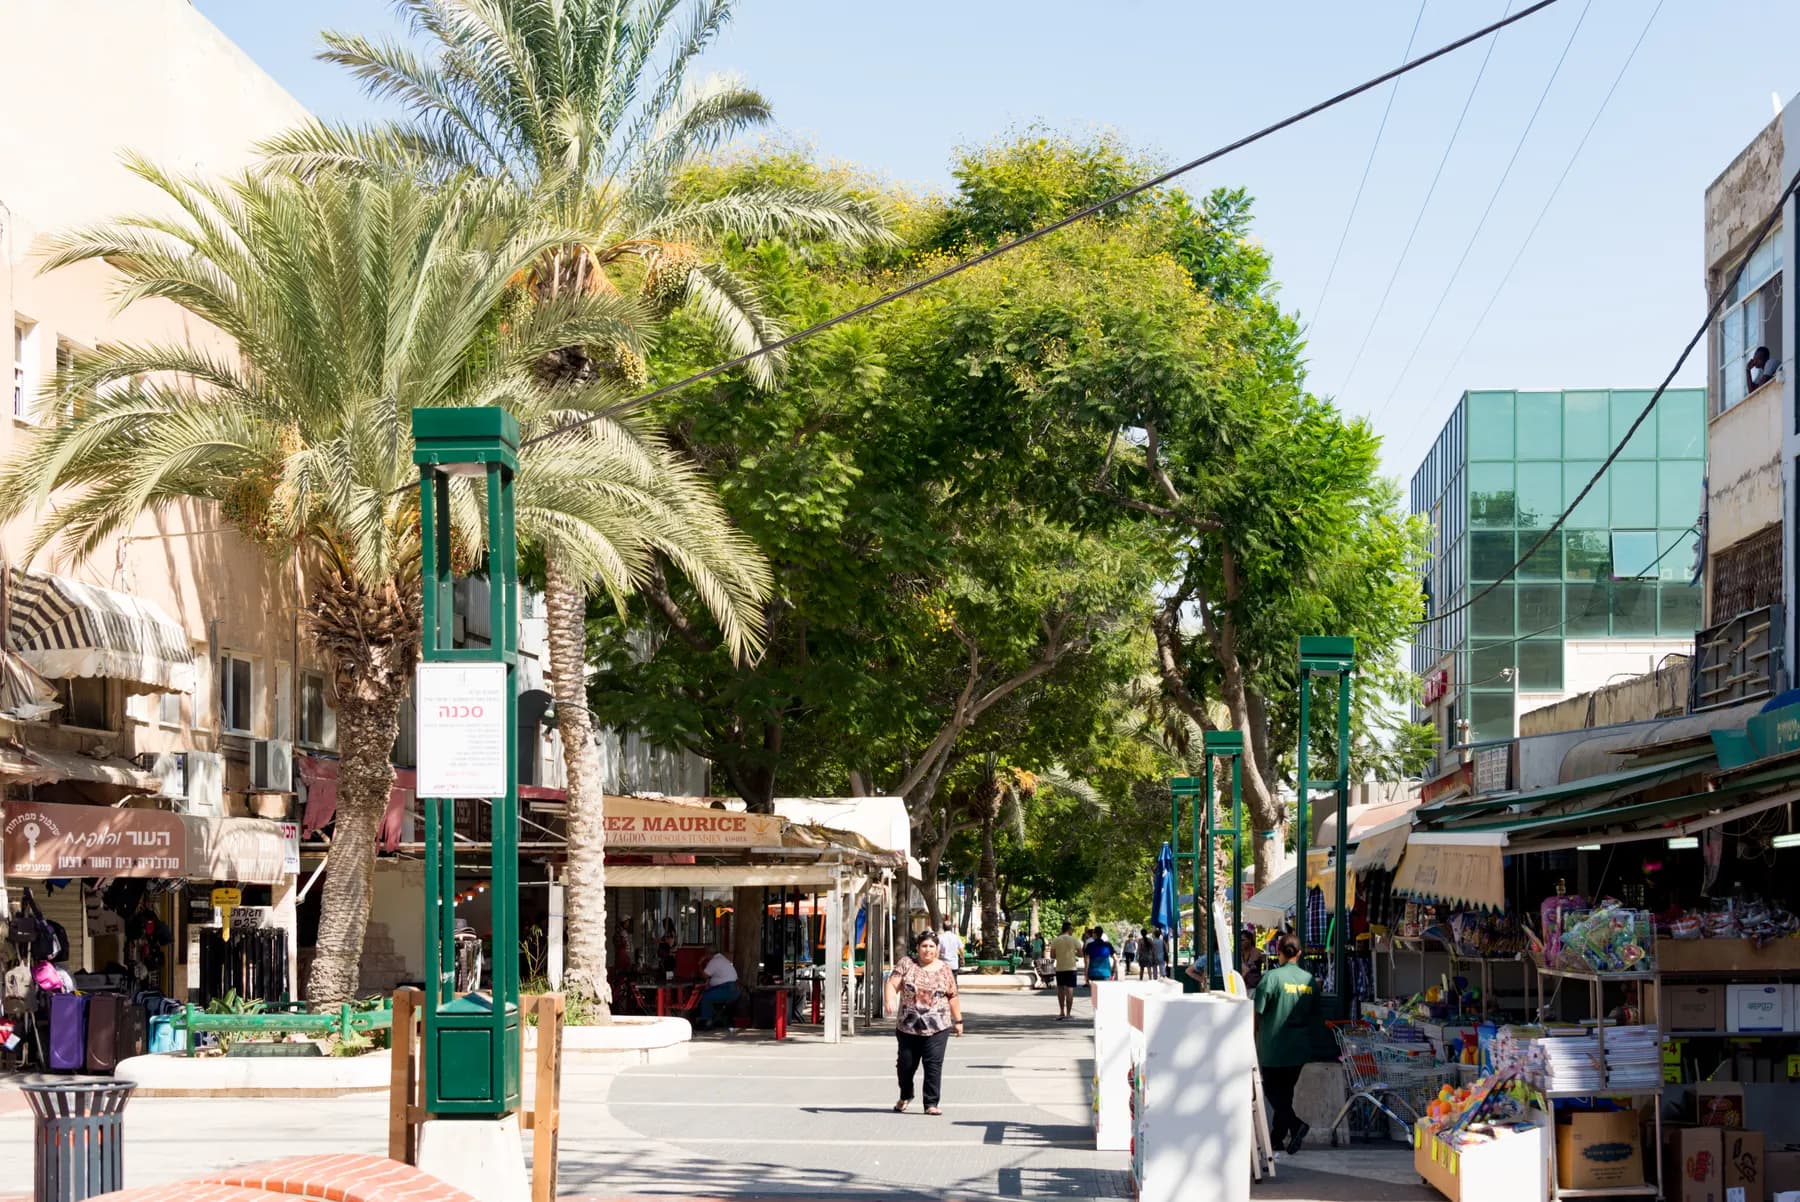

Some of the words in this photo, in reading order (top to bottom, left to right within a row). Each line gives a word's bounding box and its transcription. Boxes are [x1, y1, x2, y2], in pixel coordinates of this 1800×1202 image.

[439, 705, 484, 718] סכנה
[5, 812, 37, 834] מפתחות
[39, 812, 61, 836] שכפול
[642, 816, 747, 832] MAURICE
[65, 827, 122, 847] והמפתח
[125, 830, 171, 846] העור
[15, 862, 52, 872] מנעולים
[58, 855, 82, 869] רצען
[88, 856, 112, 868] העור
[115, 856, 132, 869] בית
[137, 855, 180, 869] סנדלריה
